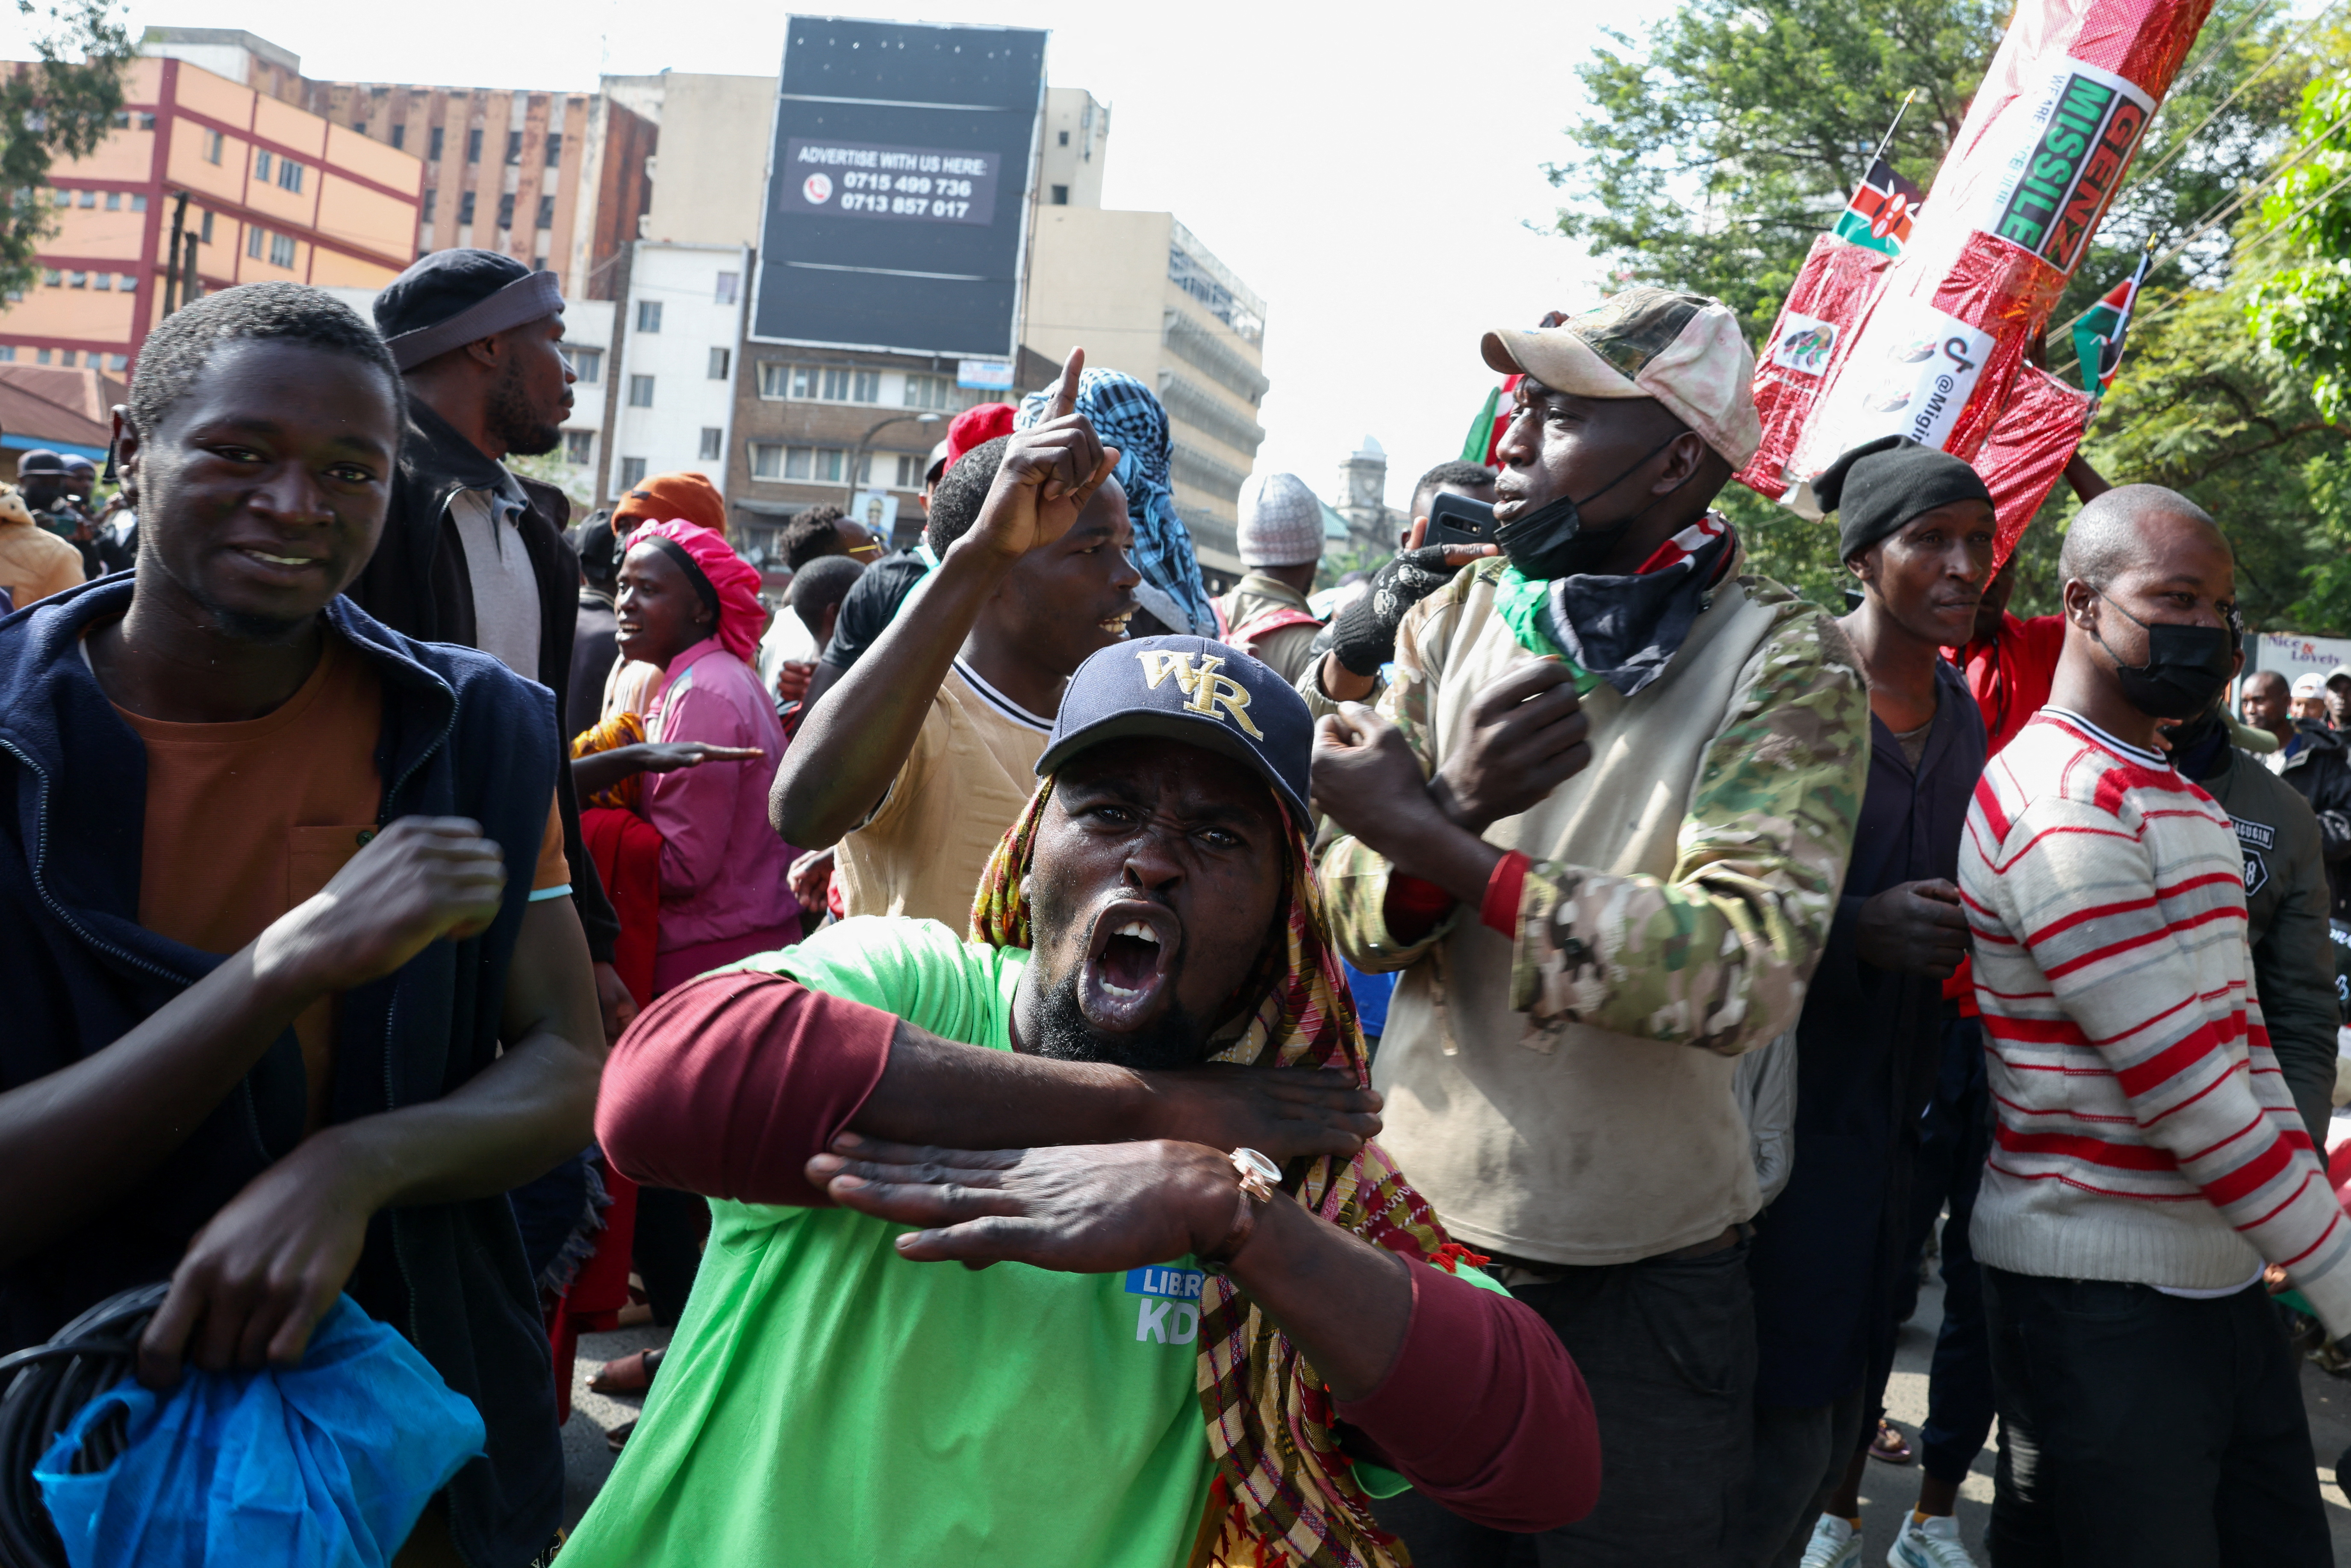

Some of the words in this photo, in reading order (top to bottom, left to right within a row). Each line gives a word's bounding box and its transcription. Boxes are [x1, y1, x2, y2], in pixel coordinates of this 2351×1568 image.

[2033, 99, 2053, 124] ARE
[798, 146, 878, 168] ADVERTISE
[880, 152, 917, 171] WITH
[919, 155, 940, 173] US
[942, 156, 987, 176] HERE:
[2000, 78, 2111, 247] MISSILE
[843, 171, 892, 191] 0715
[895, 175, 931, 194] 499
[936, 178, 972, 197] 736
[841, 192, 889, 212] 0713
[892, 196, 929, 215] 857
[932, 199, 969, 218] 017
[2269, 635, 2301, 647] Nice
[2302, 643, 2316, 654] &
[2292, 650, 2342, 666] Lovely
[1135, 649, 1264, 742] WR
